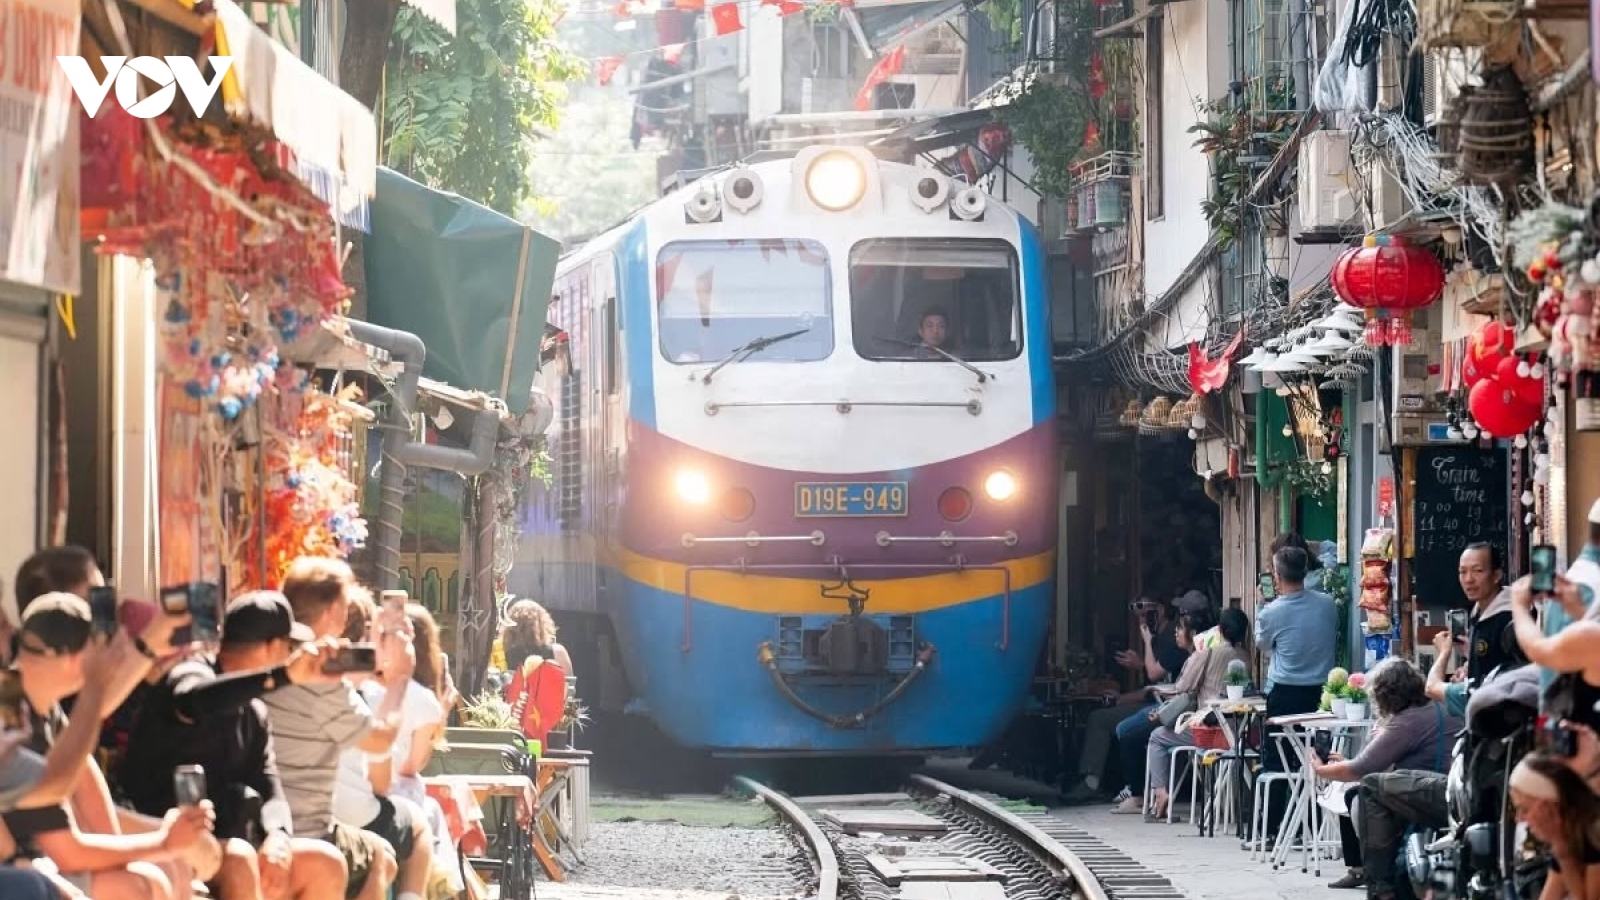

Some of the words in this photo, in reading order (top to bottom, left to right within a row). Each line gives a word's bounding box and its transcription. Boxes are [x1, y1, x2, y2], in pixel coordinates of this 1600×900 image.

[1431, 456, 1480, 484] Train
[800, 487, 902, 511] D19E-949
[1451, 485, 1485, 503] time
